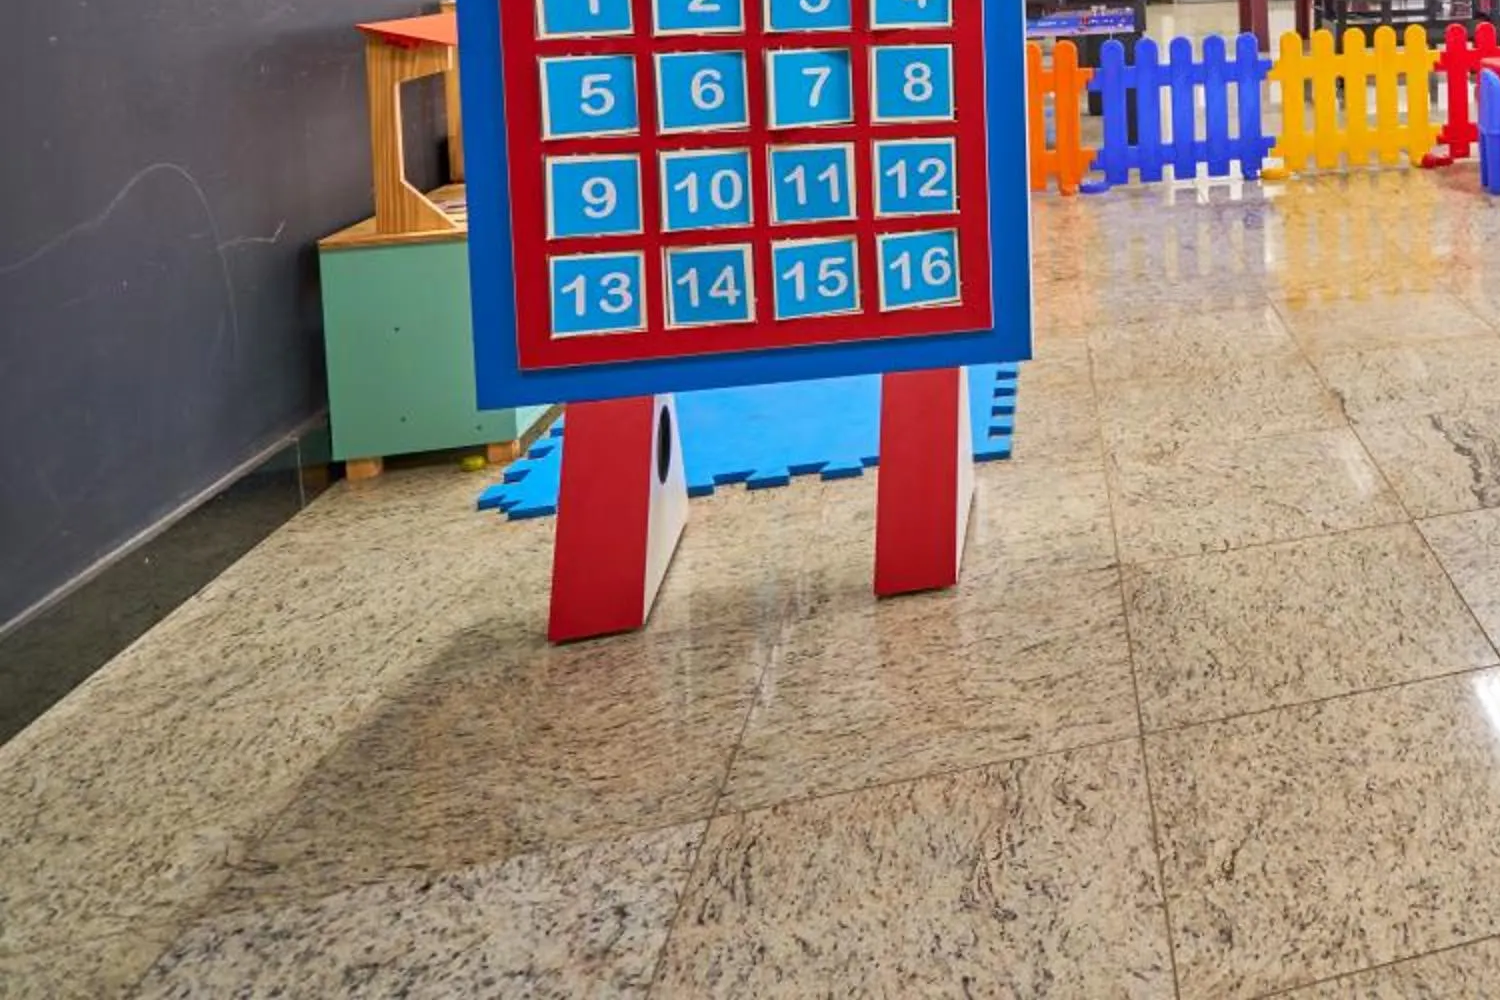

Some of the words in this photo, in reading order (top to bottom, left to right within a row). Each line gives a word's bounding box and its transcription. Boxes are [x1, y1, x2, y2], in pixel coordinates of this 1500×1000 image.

[580, 73, 615, 116] 5
[690, 69, 725, 109] 6
[802, 66, 831, 107] 7
[903, 62, 933, 102] 8
[581, 177, 617, 218] 9
[674, 169, 743, 213] 10
[783, 163, 841, 205] 11
[885, 157, 948, 199] 12
[561, 271, 634, 317] 13
[676, 265, 741, 307] 14
[782, 257, 849, 301] 15
[889, 247, 951, 290] 16
